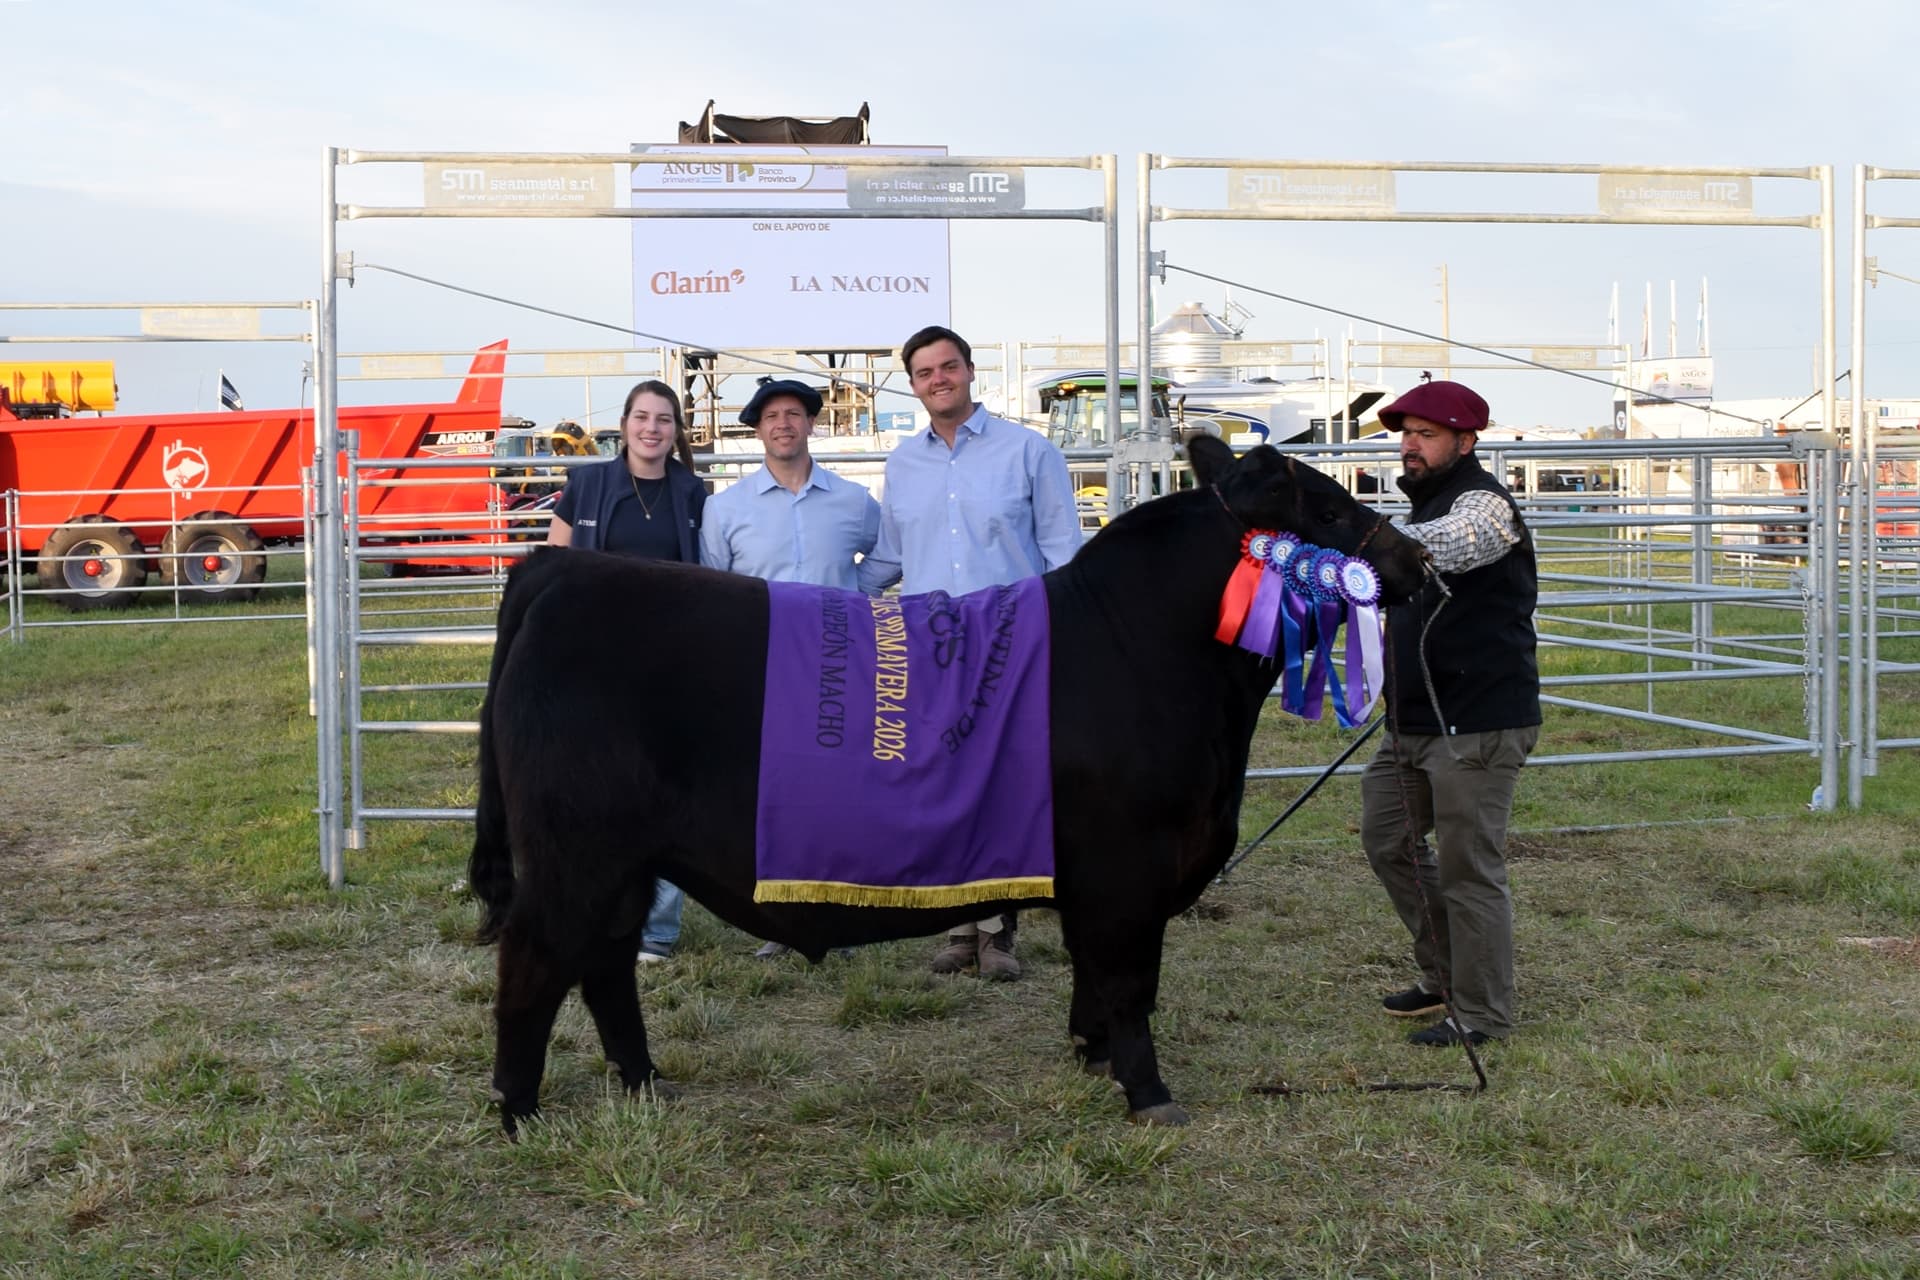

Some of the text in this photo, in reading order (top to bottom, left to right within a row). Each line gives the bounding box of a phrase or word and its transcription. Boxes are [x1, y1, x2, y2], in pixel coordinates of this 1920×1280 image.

[663, 161, 721, 175] ANGUS
[758, 167, 783, 175] Banco
[758, 175, 796, 184] Provincia
[752, 222, 830, 231] CON EL APOYO DE
[650, 270, 731, 295] Clarín
[790, 275, 931, 293] LA NACION
[436, 431, 487, 445] AKRON
[816, 663, 847, 749] MACHO
[872, 715, 907, 762] 2026
